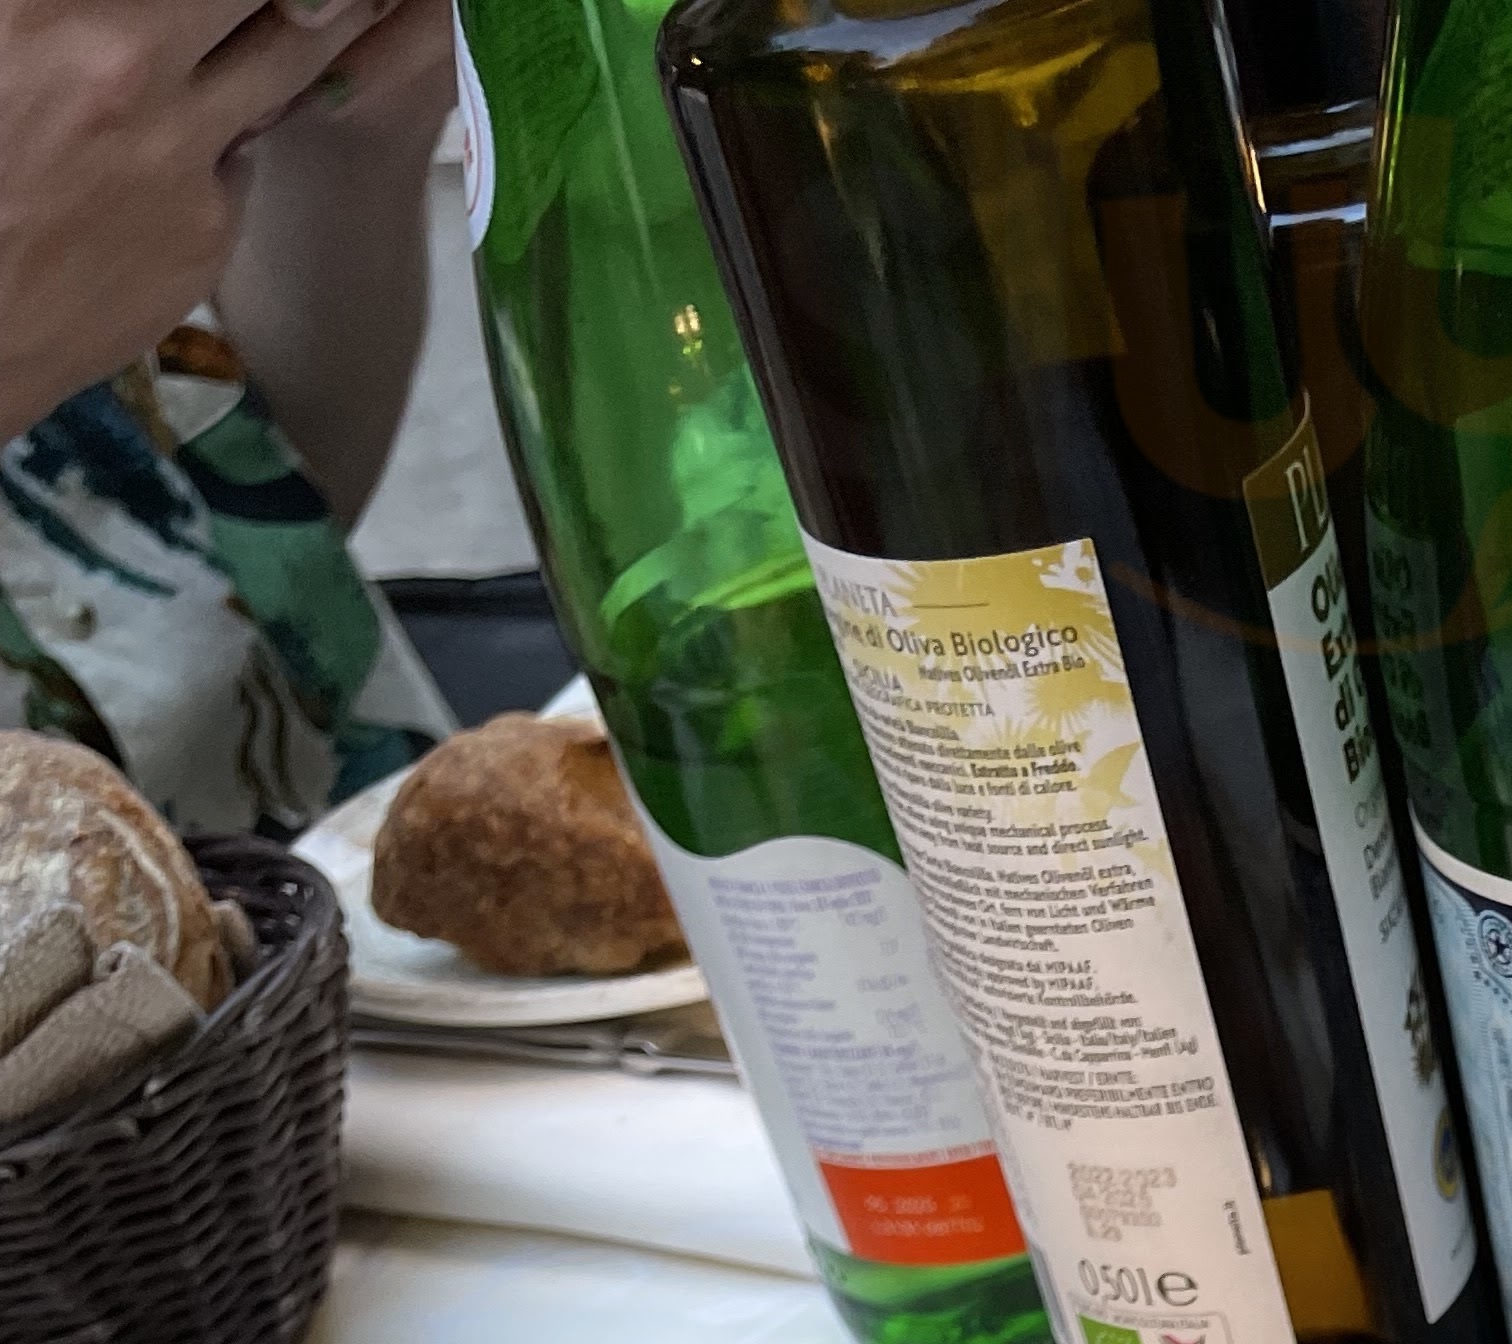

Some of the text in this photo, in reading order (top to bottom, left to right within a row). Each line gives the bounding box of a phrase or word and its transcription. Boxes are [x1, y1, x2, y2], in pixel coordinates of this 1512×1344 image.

[886, 628, 945, 656] Oliva
[950, 624, 1078, 658] Biologico
[963, 661, 1022, 682] Olivenöl
[1022, 659, 1060, 678] Extra
[1061, 656, 1086, 672] Bio
[924, 700, 995, 718] PROTETTA
[1048, 739, 1081, 756] olive
[1026, 841, 1049, 856] and
[1051, 839, 1089, 854] direct
[1089, 878, 1154, 898] Verfahren
[1048, 901, 1080, 919] Licht
[1081, 900, 1107, 917] und
[1091, 918, 1135, 934] Oliven
